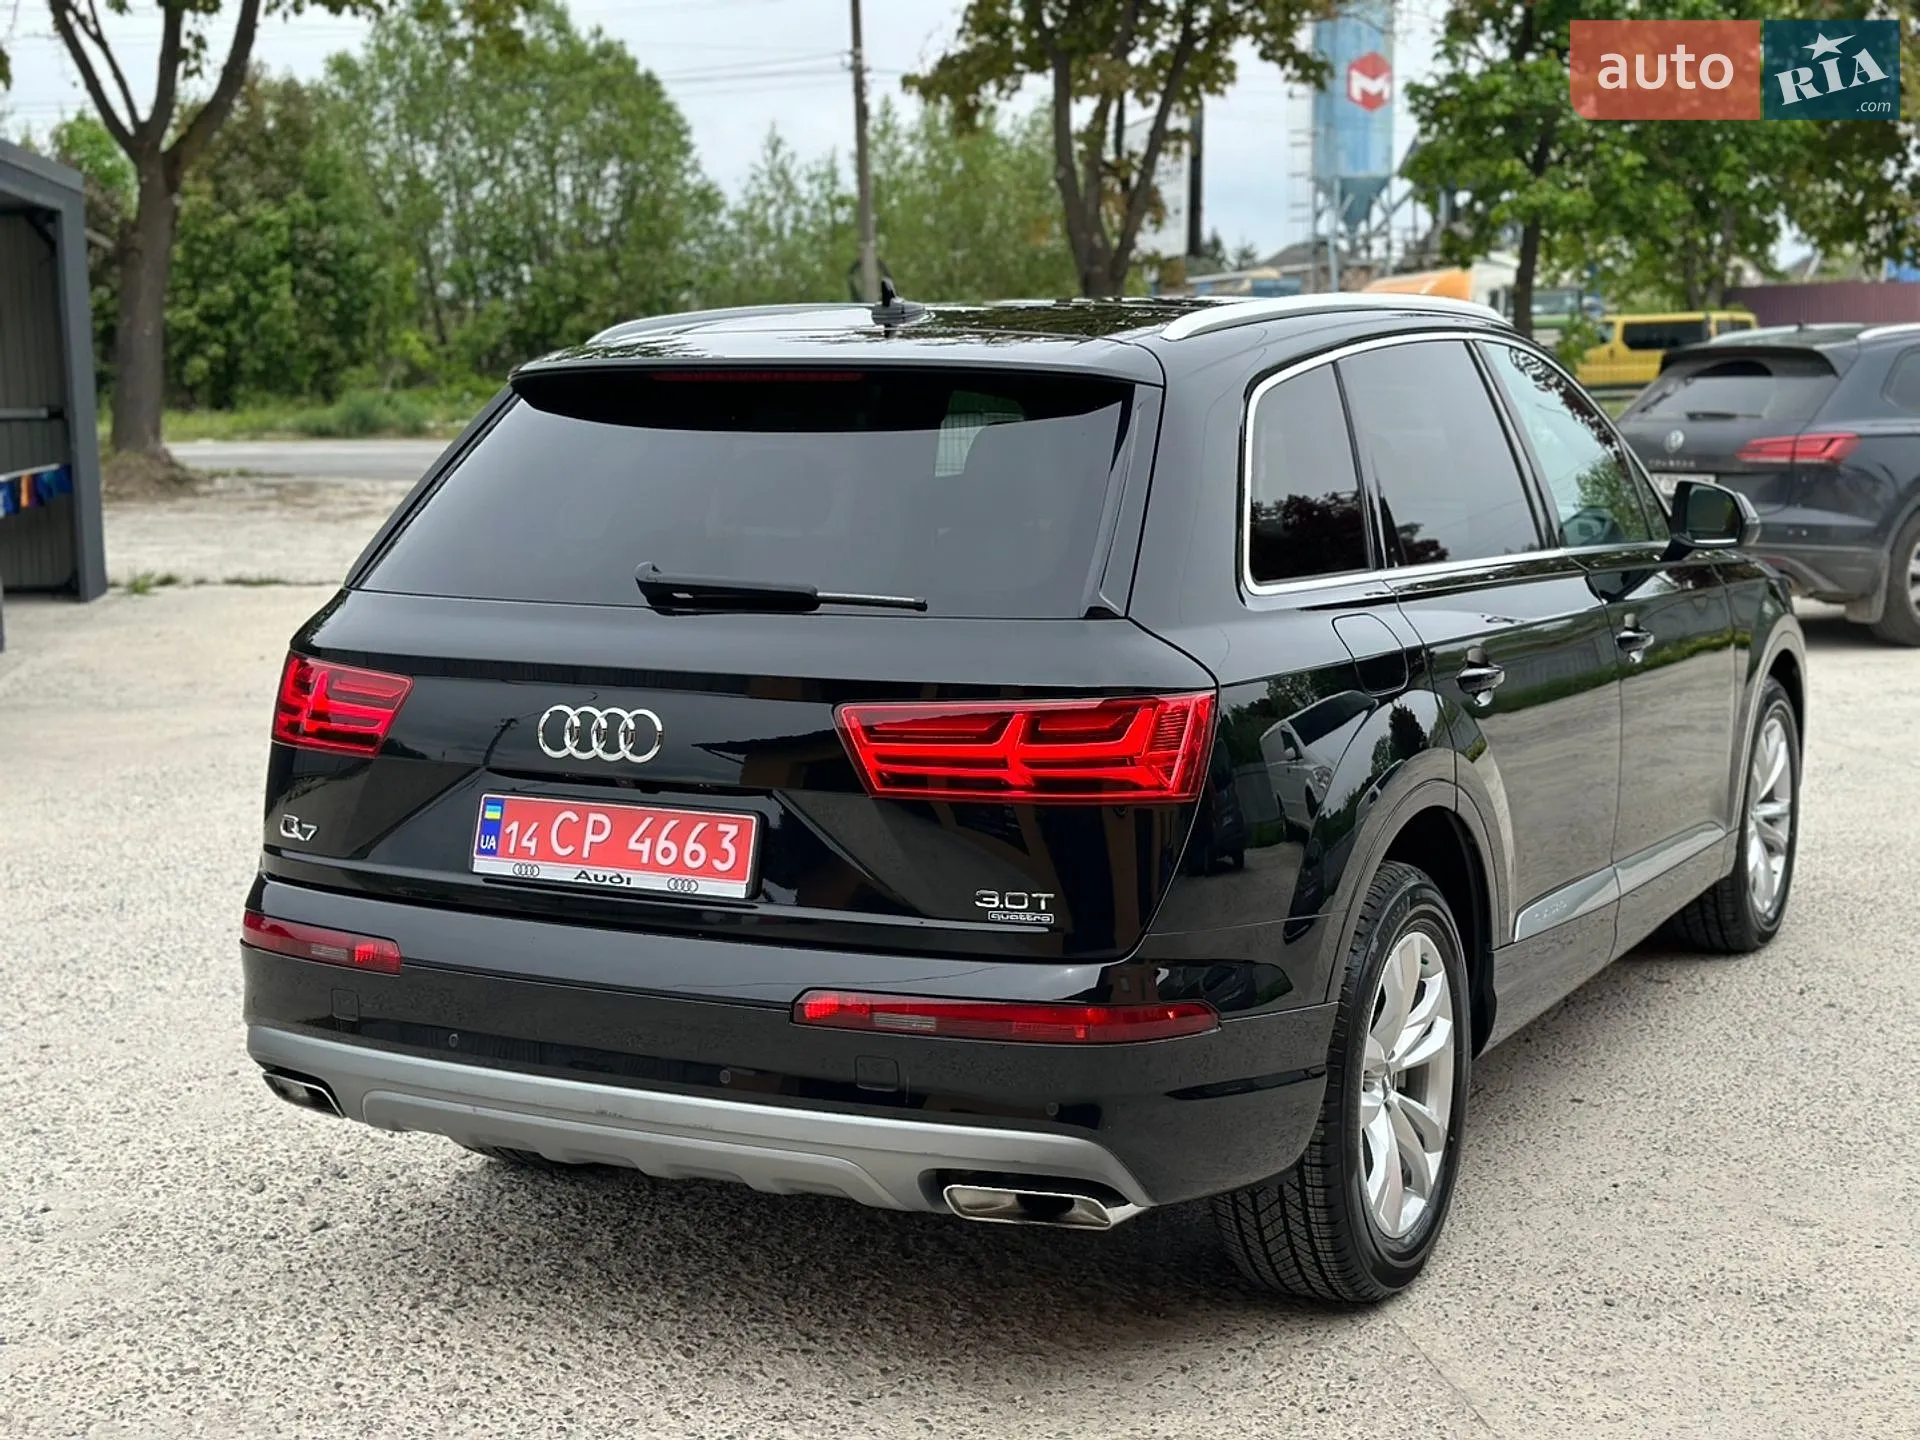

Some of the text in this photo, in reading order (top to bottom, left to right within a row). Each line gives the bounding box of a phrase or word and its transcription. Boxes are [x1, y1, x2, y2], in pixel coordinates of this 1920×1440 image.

[280, 814, 318, 841] Q7
[480, 834, 497, 850] UA
[504, 810, 740, 872] 14 CP 4663
[573, 869, 632, 886] Audi
[990, 912, 1051, 922] quattro
